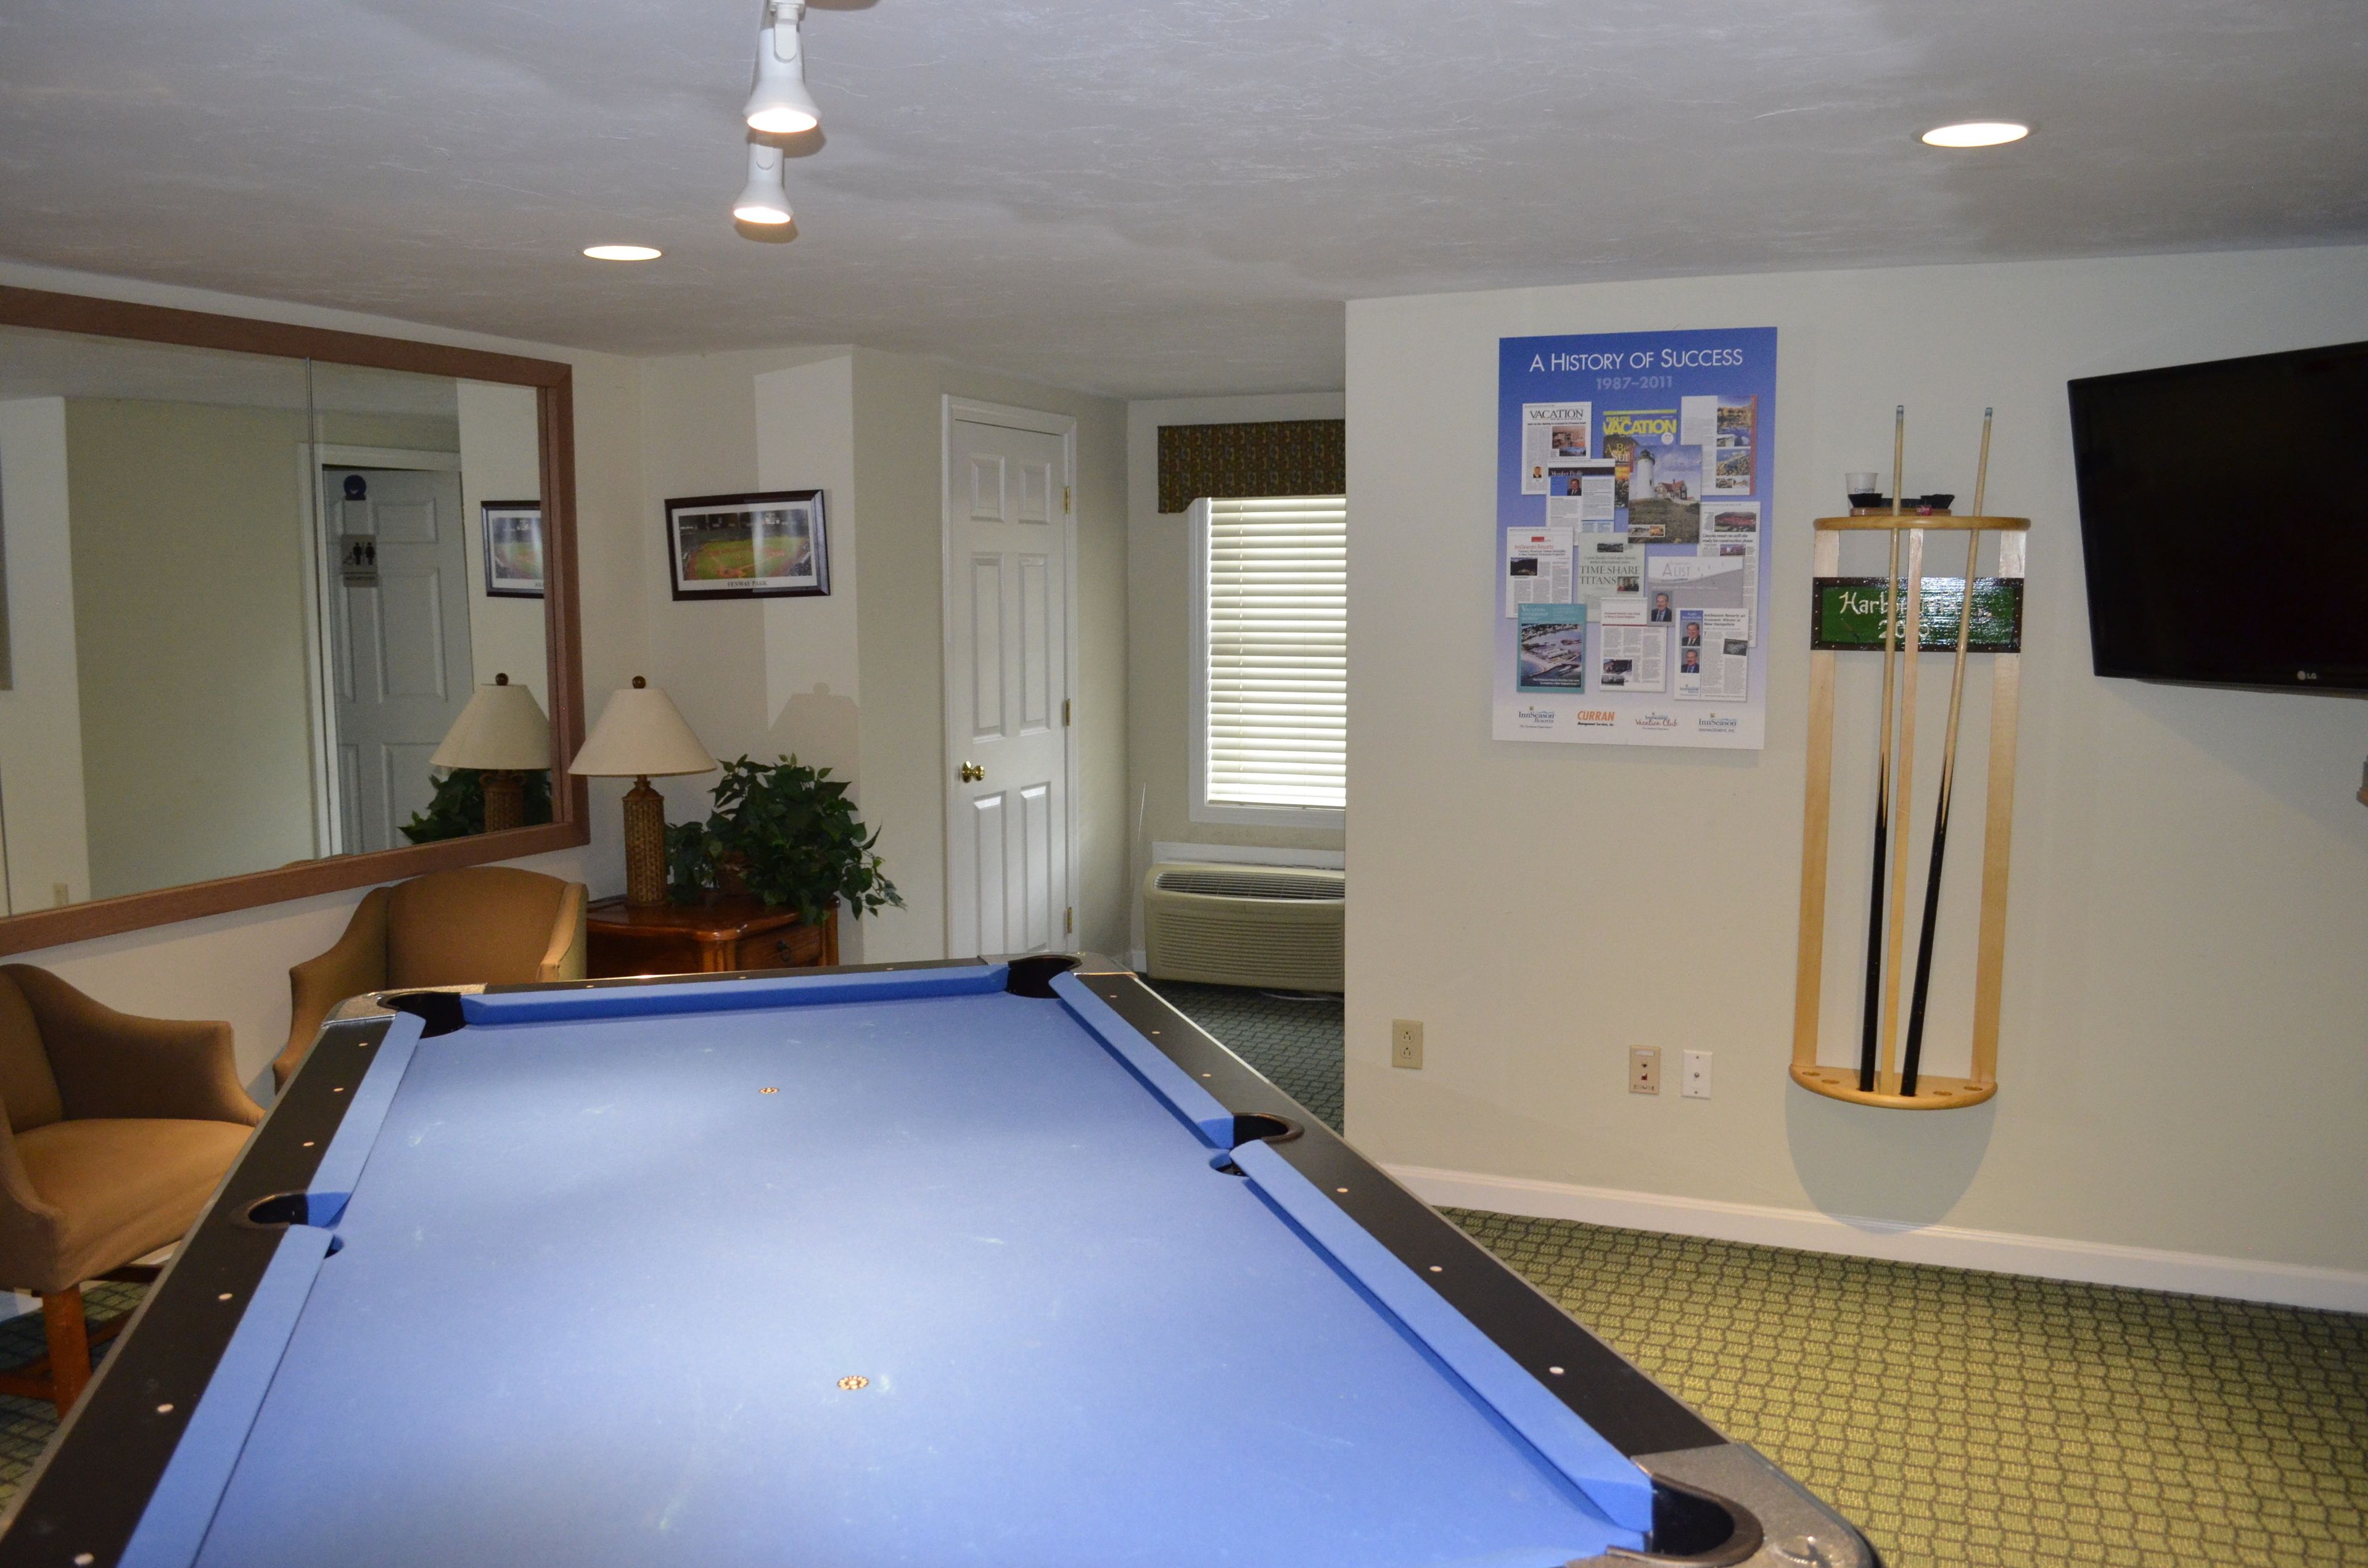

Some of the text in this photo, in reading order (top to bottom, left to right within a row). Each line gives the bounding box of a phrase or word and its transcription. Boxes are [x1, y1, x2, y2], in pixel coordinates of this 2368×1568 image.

[1529, 348, 1743, 372] A HISTORY OF SUCCESS
[1597, 376, 1672, 390] 1987-2011
[1530, 409, 1584, 419] VACATION
[1603, 419, 1677, 435] VACATION
[1579, 566, 1640, 574] TIME SHARE
[1663, 562, 1690, 577] A LIST
[1579, 577, 1616, 585] TITANS
[2306, 672, 2317, 680] LG
[1519, 711, 1555, 719] InnSeason
[1577, 710, 1615, 721] CURRAN
[1662, 718, 1678, 727] Club
[1698, 718, 1737, 726] InnSeason
